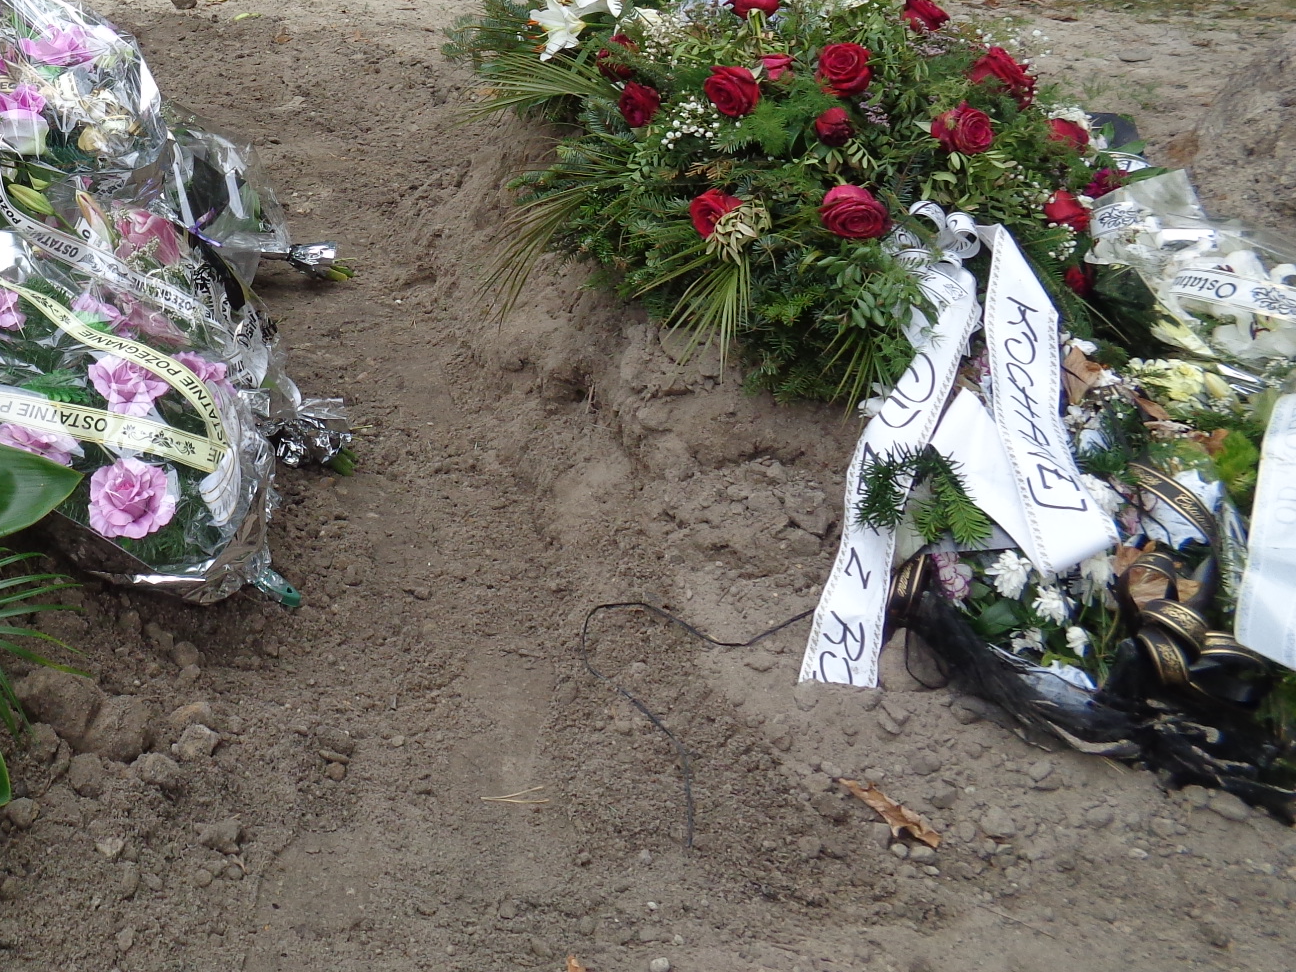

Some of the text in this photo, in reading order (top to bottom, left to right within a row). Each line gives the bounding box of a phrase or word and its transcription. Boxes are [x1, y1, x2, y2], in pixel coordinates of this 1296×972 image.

[78, 329, 183, 377] POŻEGNANIE
[16, 401, 109, 433] OSTATNIE
[179, 375, 225, 444] STATNIE
